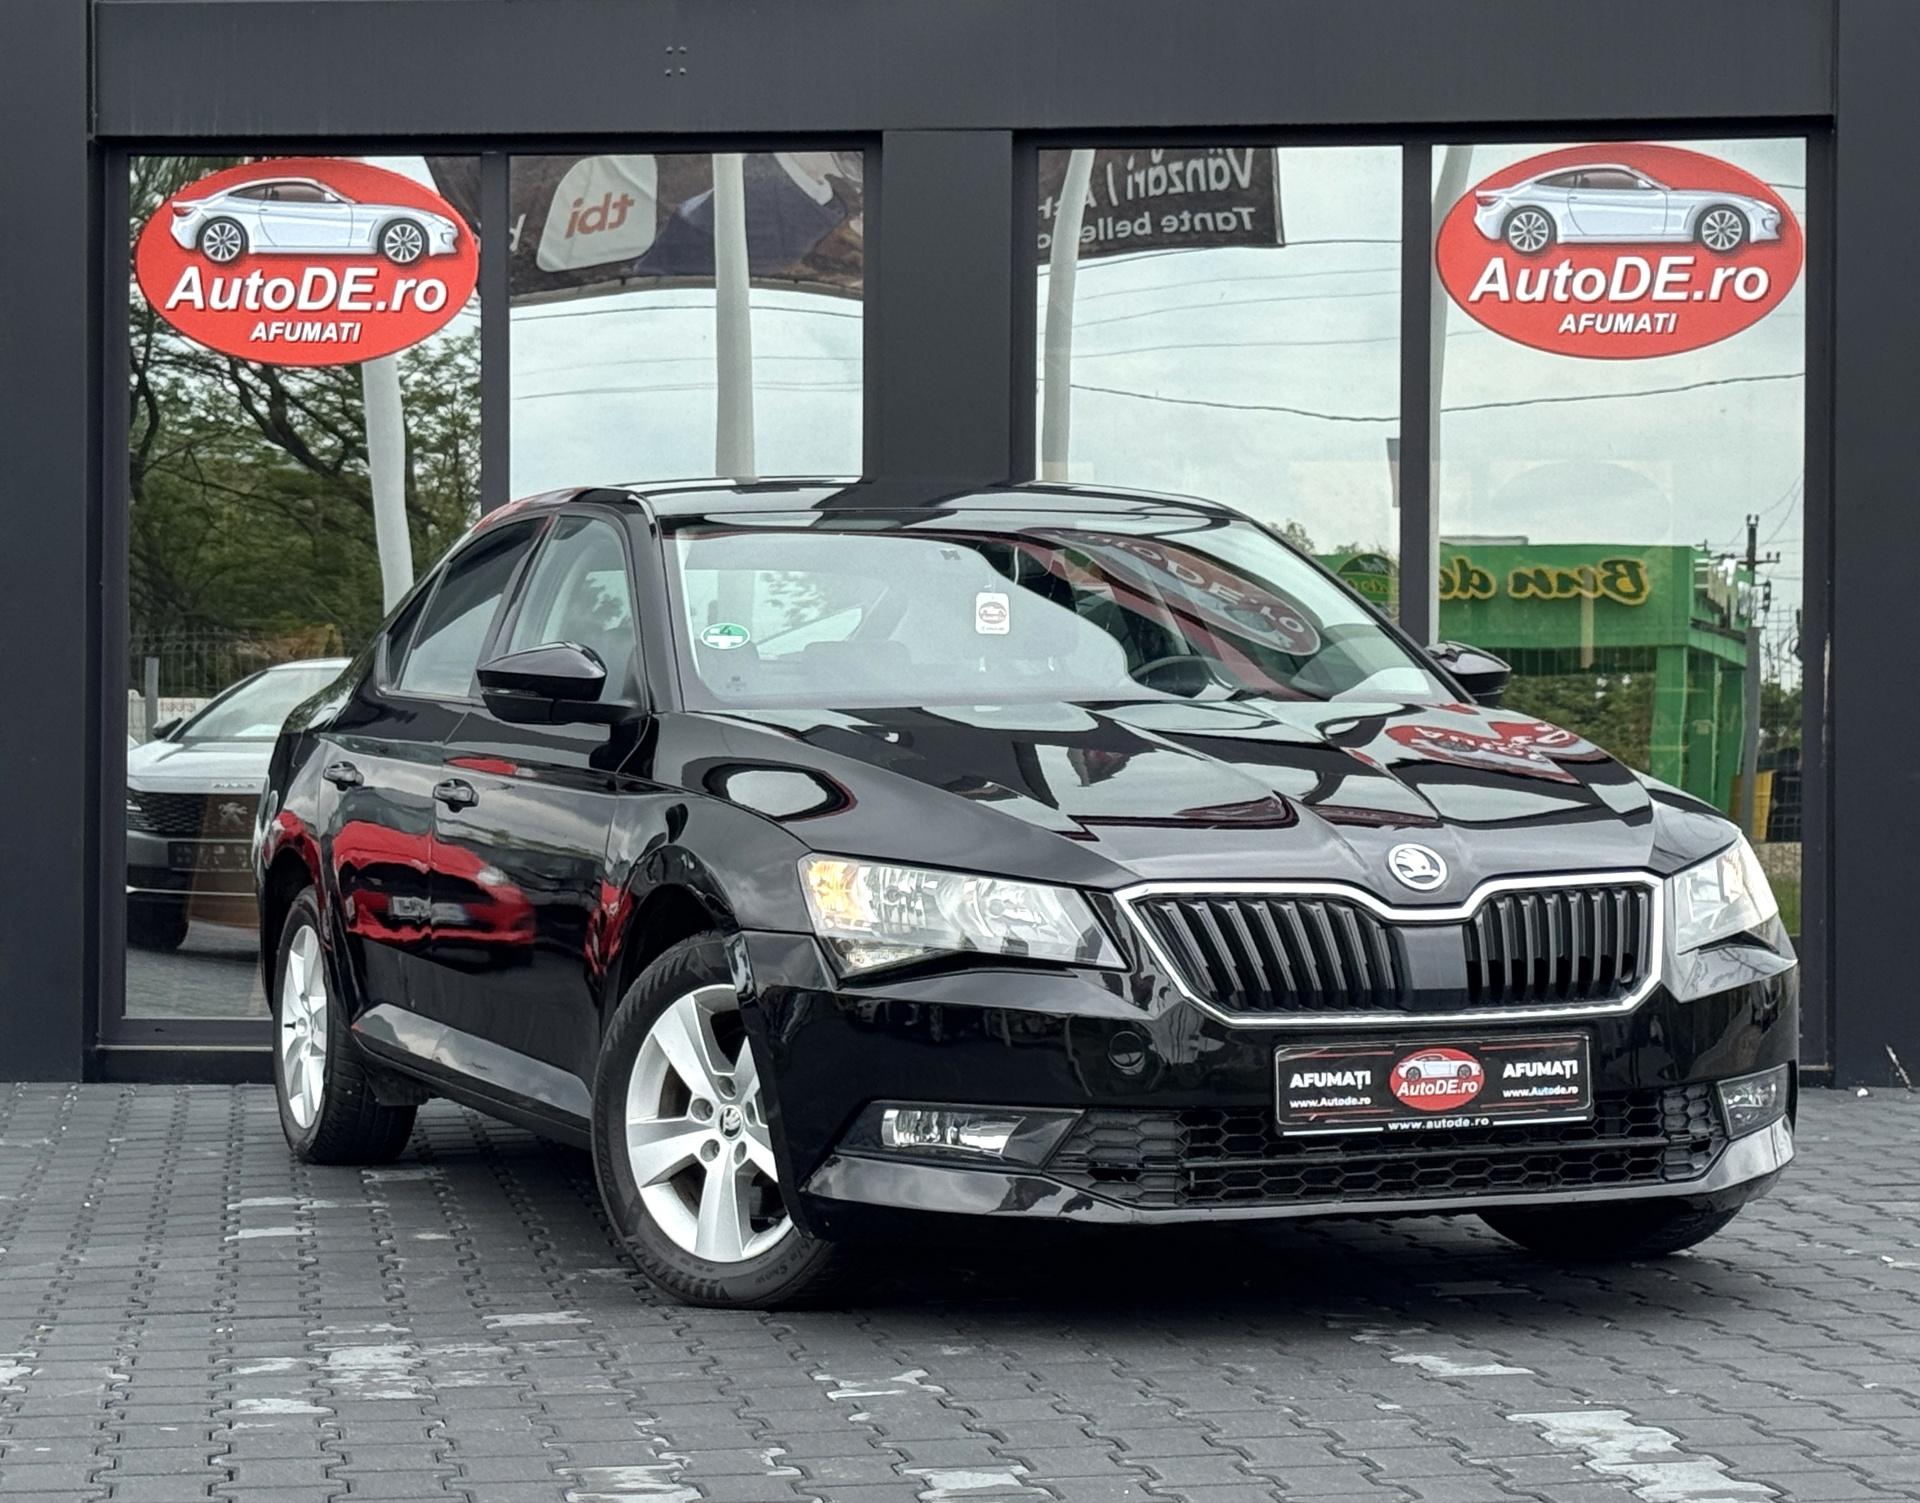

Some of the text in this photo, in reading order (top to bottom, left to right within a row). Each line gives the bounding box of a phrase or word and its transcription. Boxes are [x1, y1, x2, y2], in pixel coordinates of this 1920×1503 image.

[165, 266, 448, 312] AutoDE.ro
[1468, 255, 1770, 303] AutoDE.ro
[249, 321, 363, 343] AFUMATI
[1558, 313, 1679, 334] AFUMATI
[1396, 1079, 1479, 1098] AutoDE.ro
[1387, 1116, 1490, 1131] www.autode.ro
